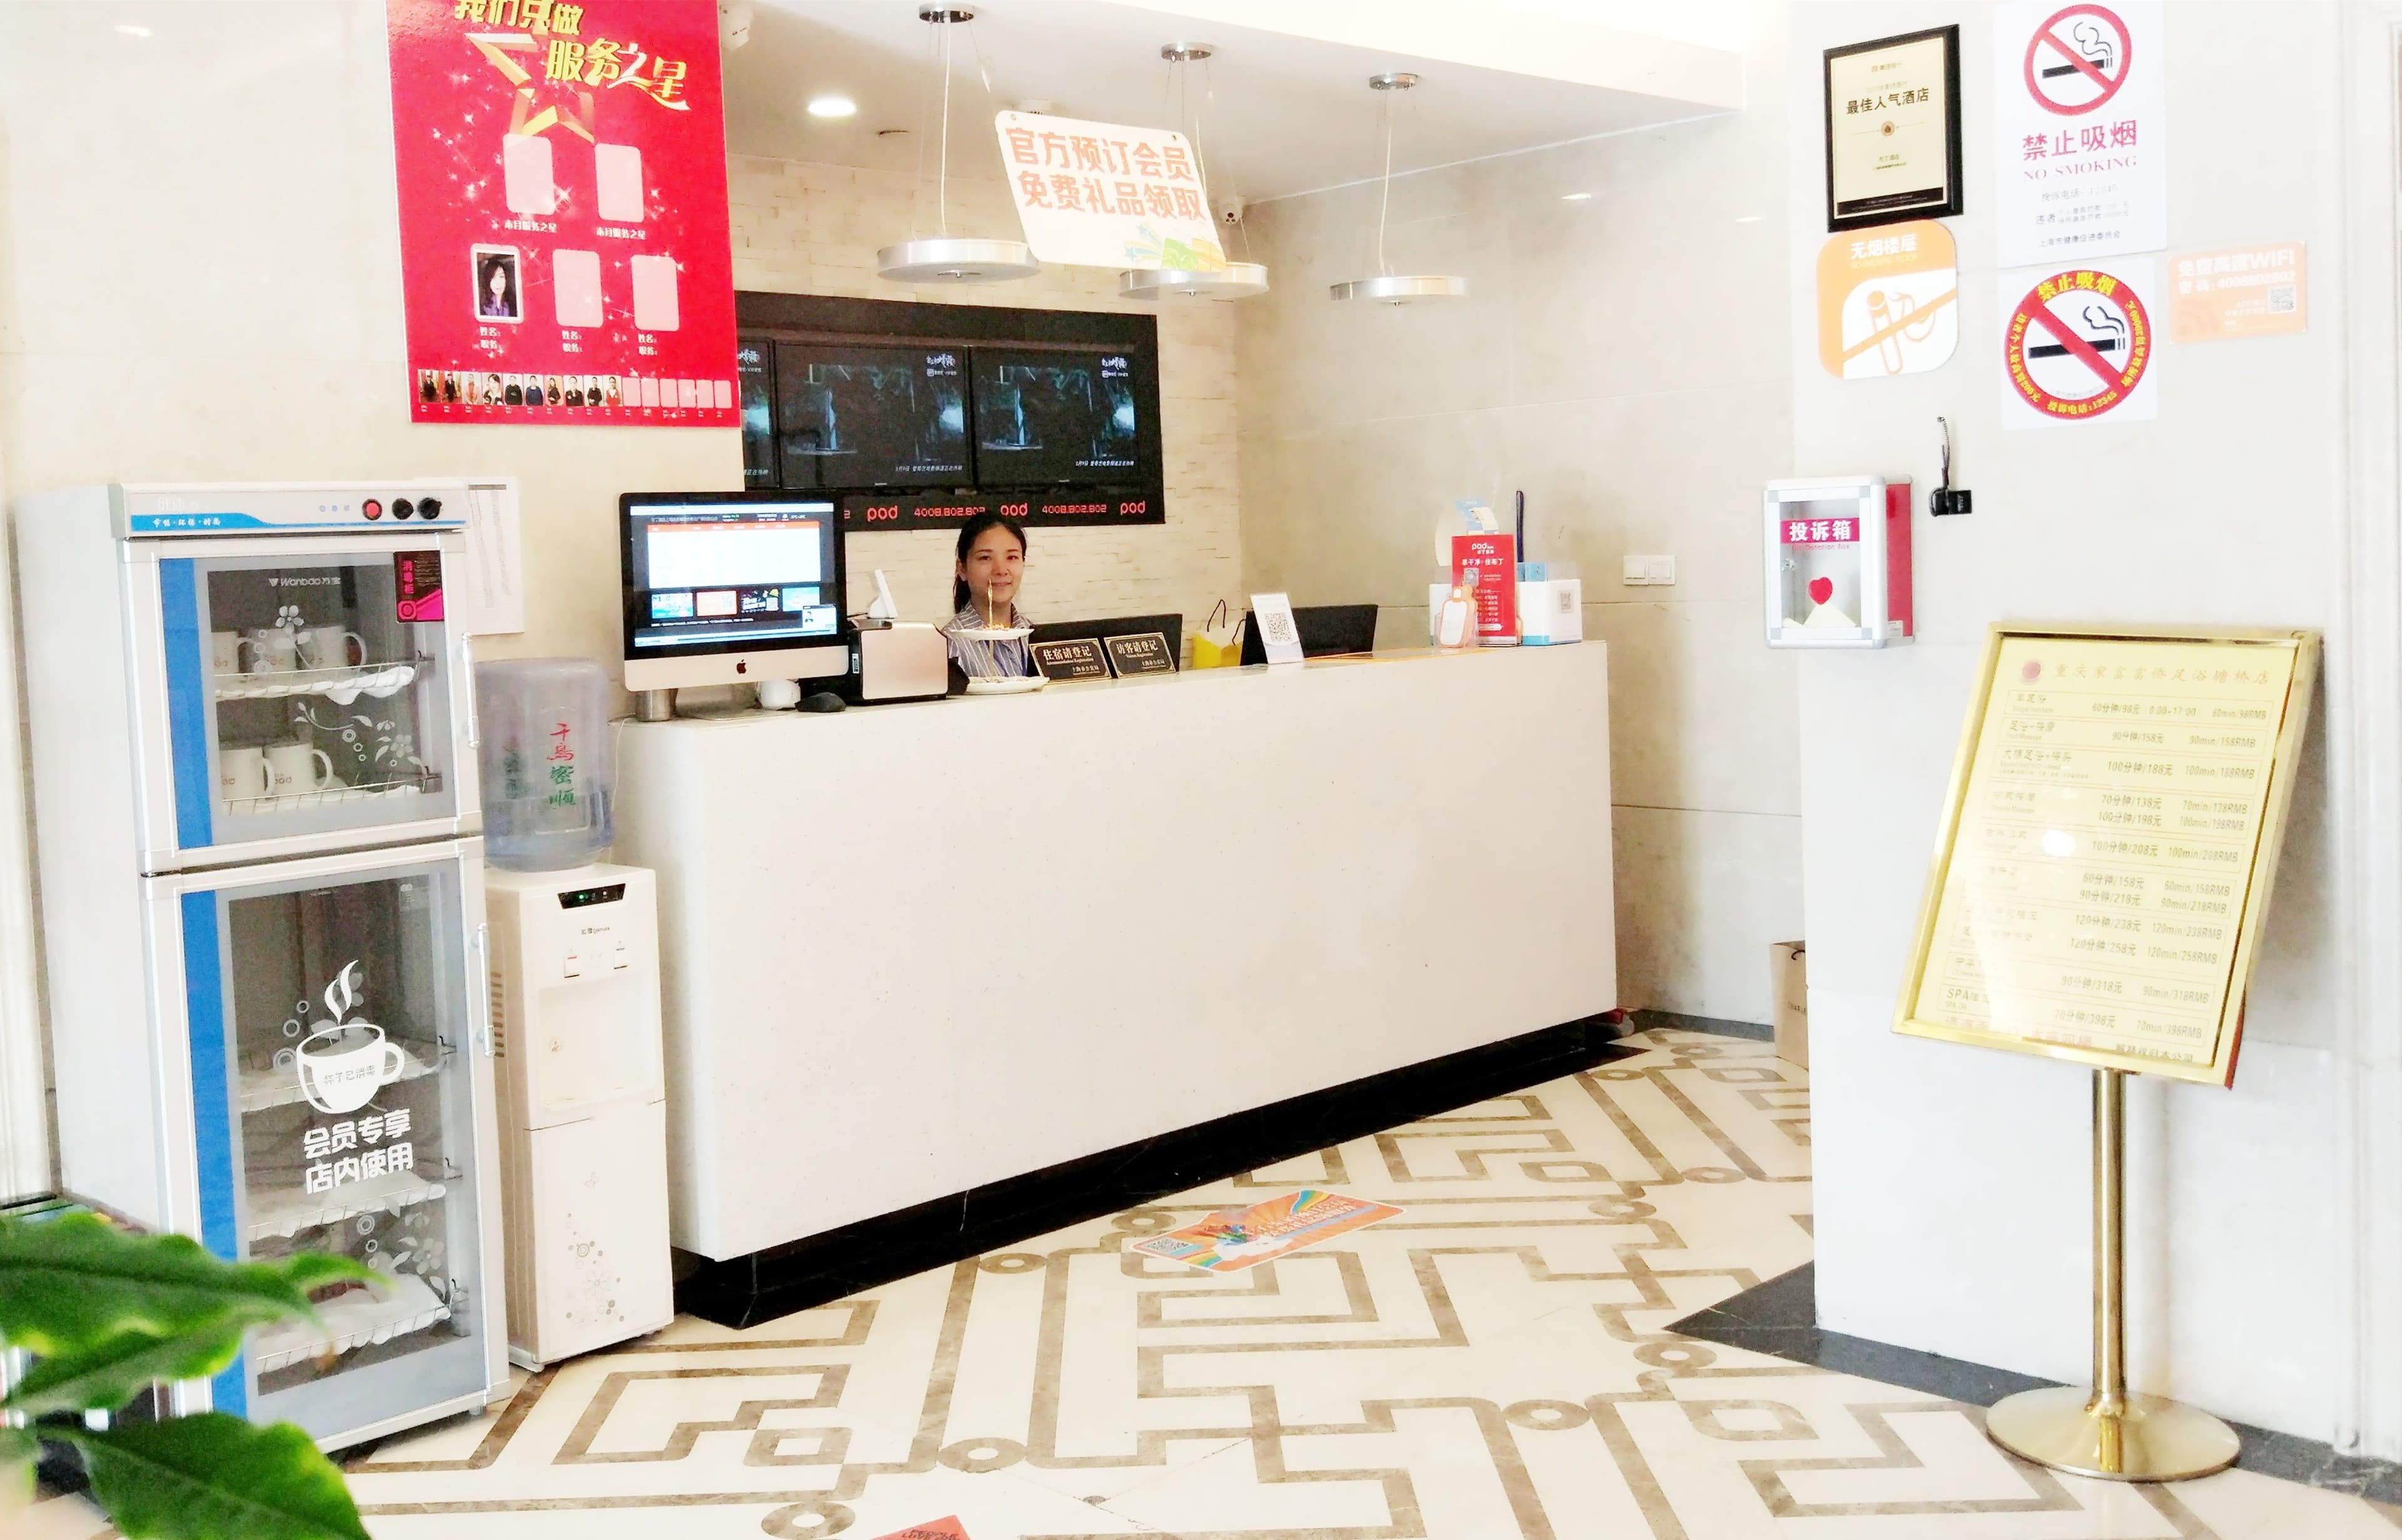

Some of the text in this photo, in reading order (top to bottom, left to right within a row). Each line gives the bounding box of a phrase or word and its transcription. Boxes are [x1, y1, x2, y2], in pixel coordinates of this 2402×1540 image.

[455, 0, 583, 35] 我们只做
[545, 38, 690, 108] 服务之星
[1847, 87, 1929, 115] 最佳人气酒店
[2022, 119, 2137, 161] 禁止吸烟
[1006, 128, 1194, 182] 官方预订会员
[2023, 155, 2137, 182] NO SMOKING
[1018, 171, 1206, 221] 免费礼品领取
[504, 219, 557, 233] 本月服务之星
[596, 227, 646, 240] 本月服务之星
[1851, 233, 1917, 260] 无烟楼层
[2037, 271, 2117, 302] 禁止吸烟
[867, 505, 898, 522] pod
[1120, 500, 1145, 515] pod
[1789, 520, 1852, 542] 投诉箱
[1043, 646, 1092, 661] 住宿请登记
[1116, 640, 1158, 655] 访客请登记
[303, 1108, 411, 1160] 会员专享
[305, 1142, 413, 1195] 店内使用
